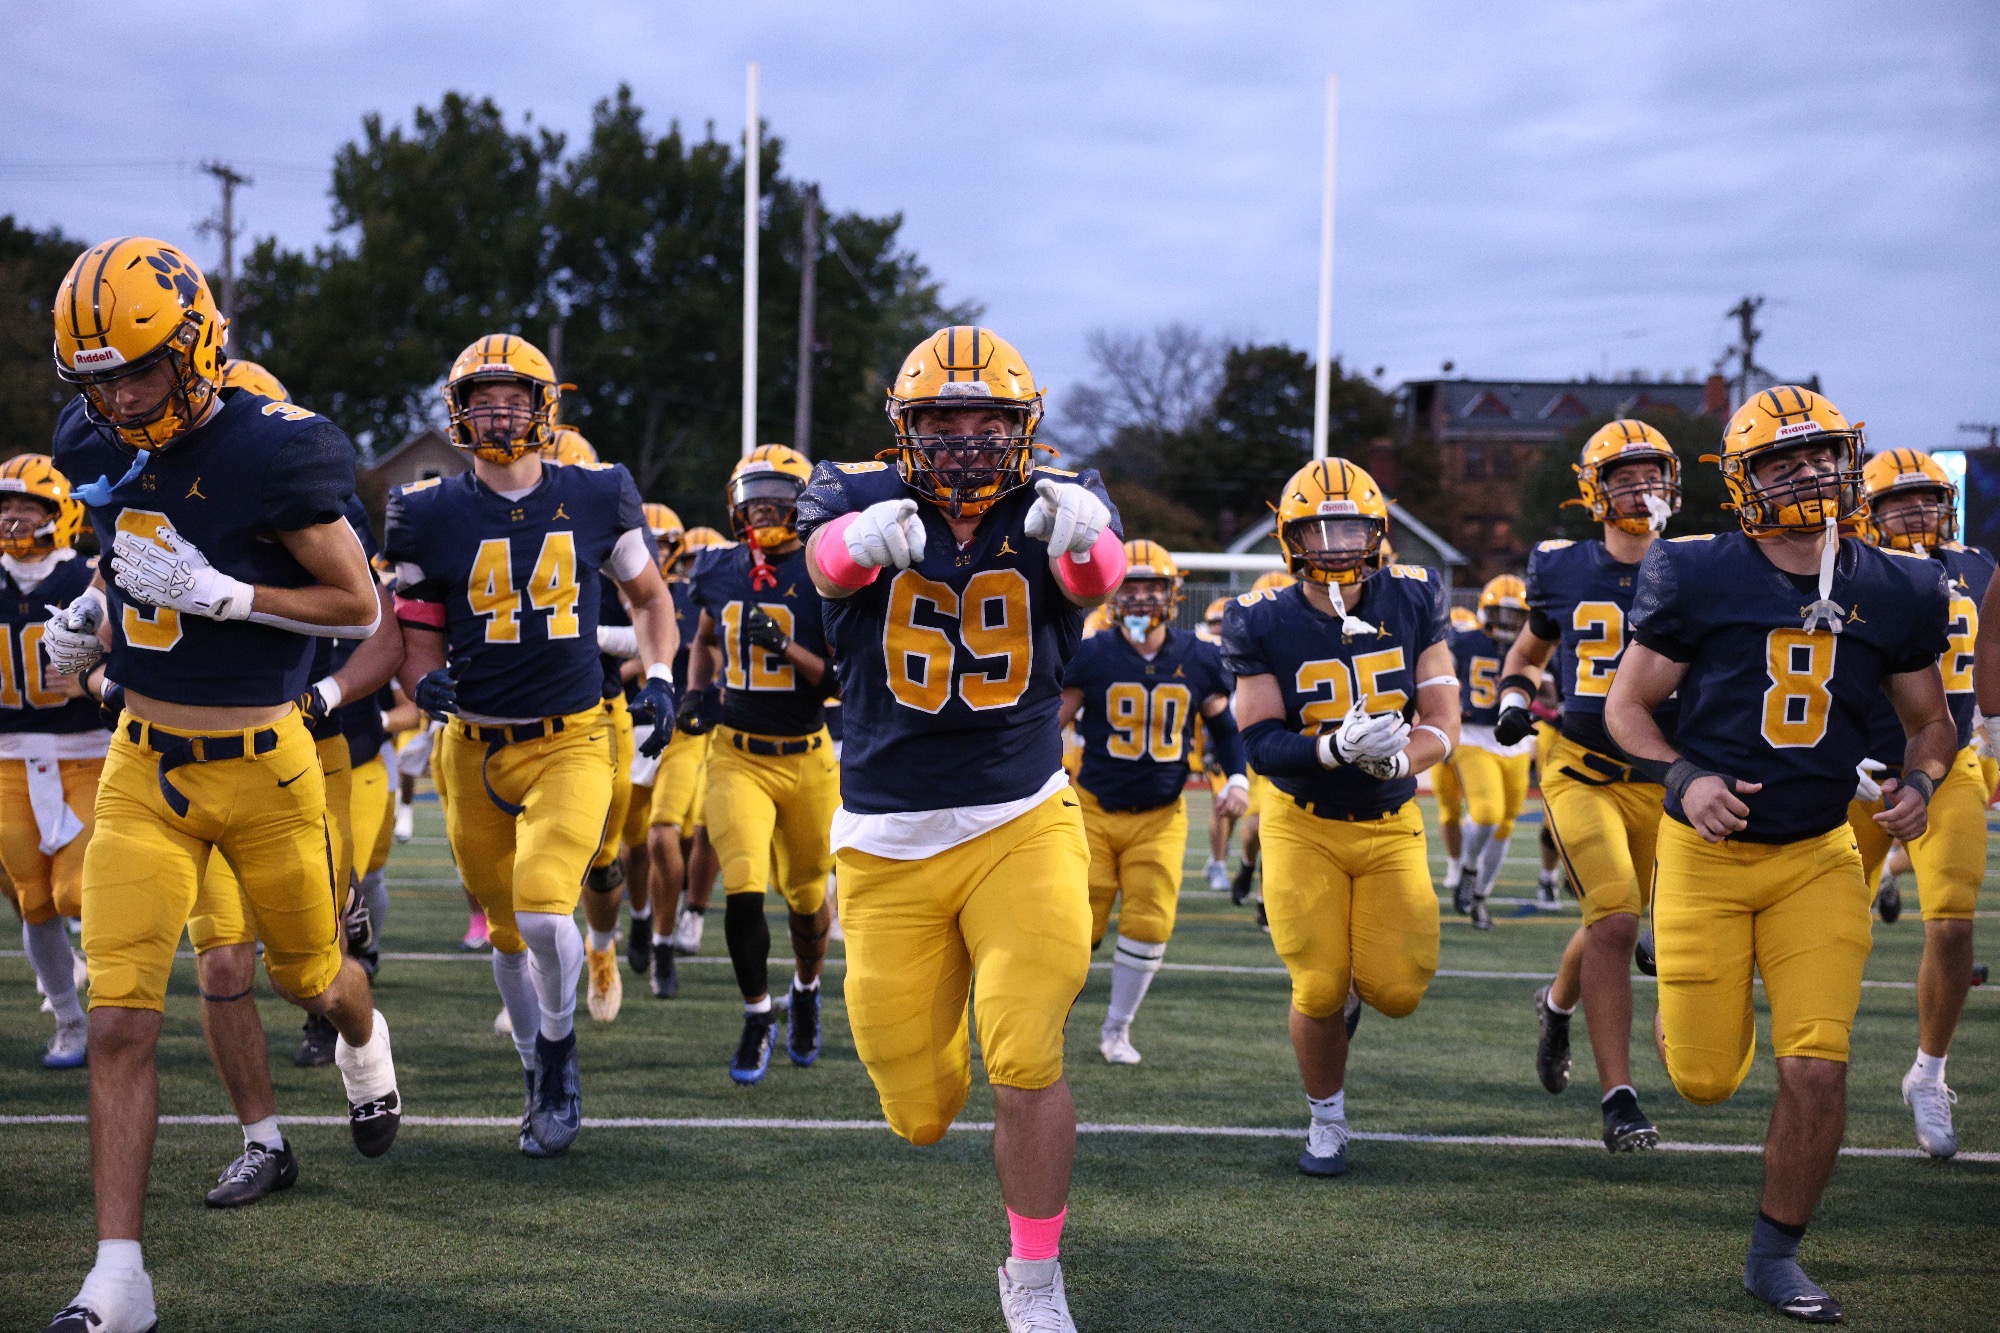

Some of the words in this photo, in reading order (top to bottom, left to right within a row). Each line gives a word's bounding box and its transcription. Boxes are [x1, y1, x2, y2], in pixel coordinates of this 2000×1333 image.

[75, 350, 114, 364] Riddell
[1780, 421, 1817, 436] Riddell
[468, 530, 580, 644] 44
[0, 622, 70, 710] 10
[721, 600, 796, 691] 12
[882, 568, 1034, 715] 69
[1573, 600, 1637, 698] 2
[1105, 681, 1192, 763] 90
[1295, 646, 1409, 737] 25
[1761, 627, 1838, 750] 8
